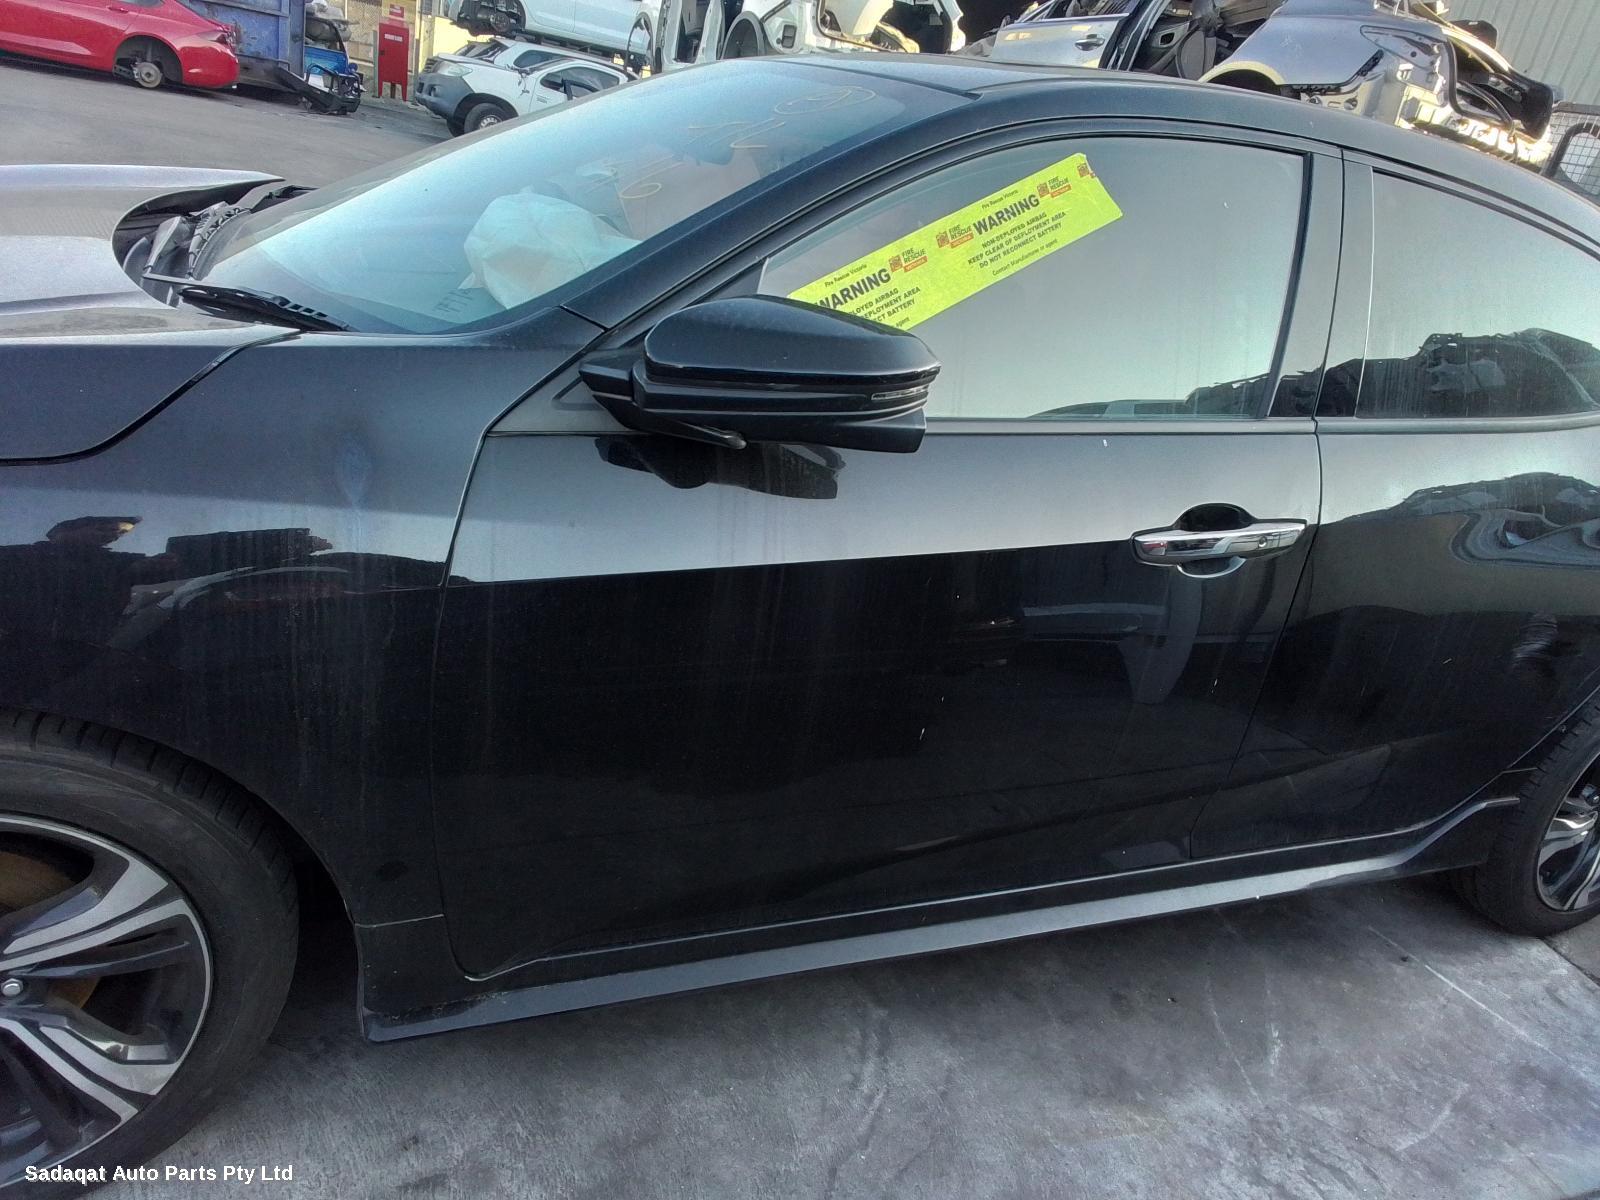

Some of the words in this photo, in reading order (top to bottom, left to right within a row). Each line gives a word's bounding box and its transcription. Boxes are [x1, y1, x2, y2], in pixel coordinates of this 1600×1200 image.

[973, 194, 1040, 236] WARNING
[948, 224, 961, 234] FIRE
[950, 225, 973, 241] RESCUE
[968, 252, 984, 265] KEEP
[985, 242, 1005, 256] CLEAR
[1005, 238, 1012, 246] OF
[1013, 219, 1050, 241] DEPLOYMENT
[1051, 211, 1066, 222] AREA
[982, 223, 1026, 249] NON-DEPLOYED
[1027, 211, 1047, 226] AIRBAG
[902, 247, 914, 257] FIRE
[979, 260, 989, 269] DO
[989, 253, 1002, 264] NOT
[1003, 235, 1037, 257] RECONNECT
[1037, 222, 1062, 238] BATTERY
[904, 248, 926, 264] RESCUE
[862, 296, 902, 319] EPLOYMENT
[903, 286, 921, 299] AREA
[875, 287, 899, 304] AIRBAG
[887, 298, 915, 317] BATTERY
